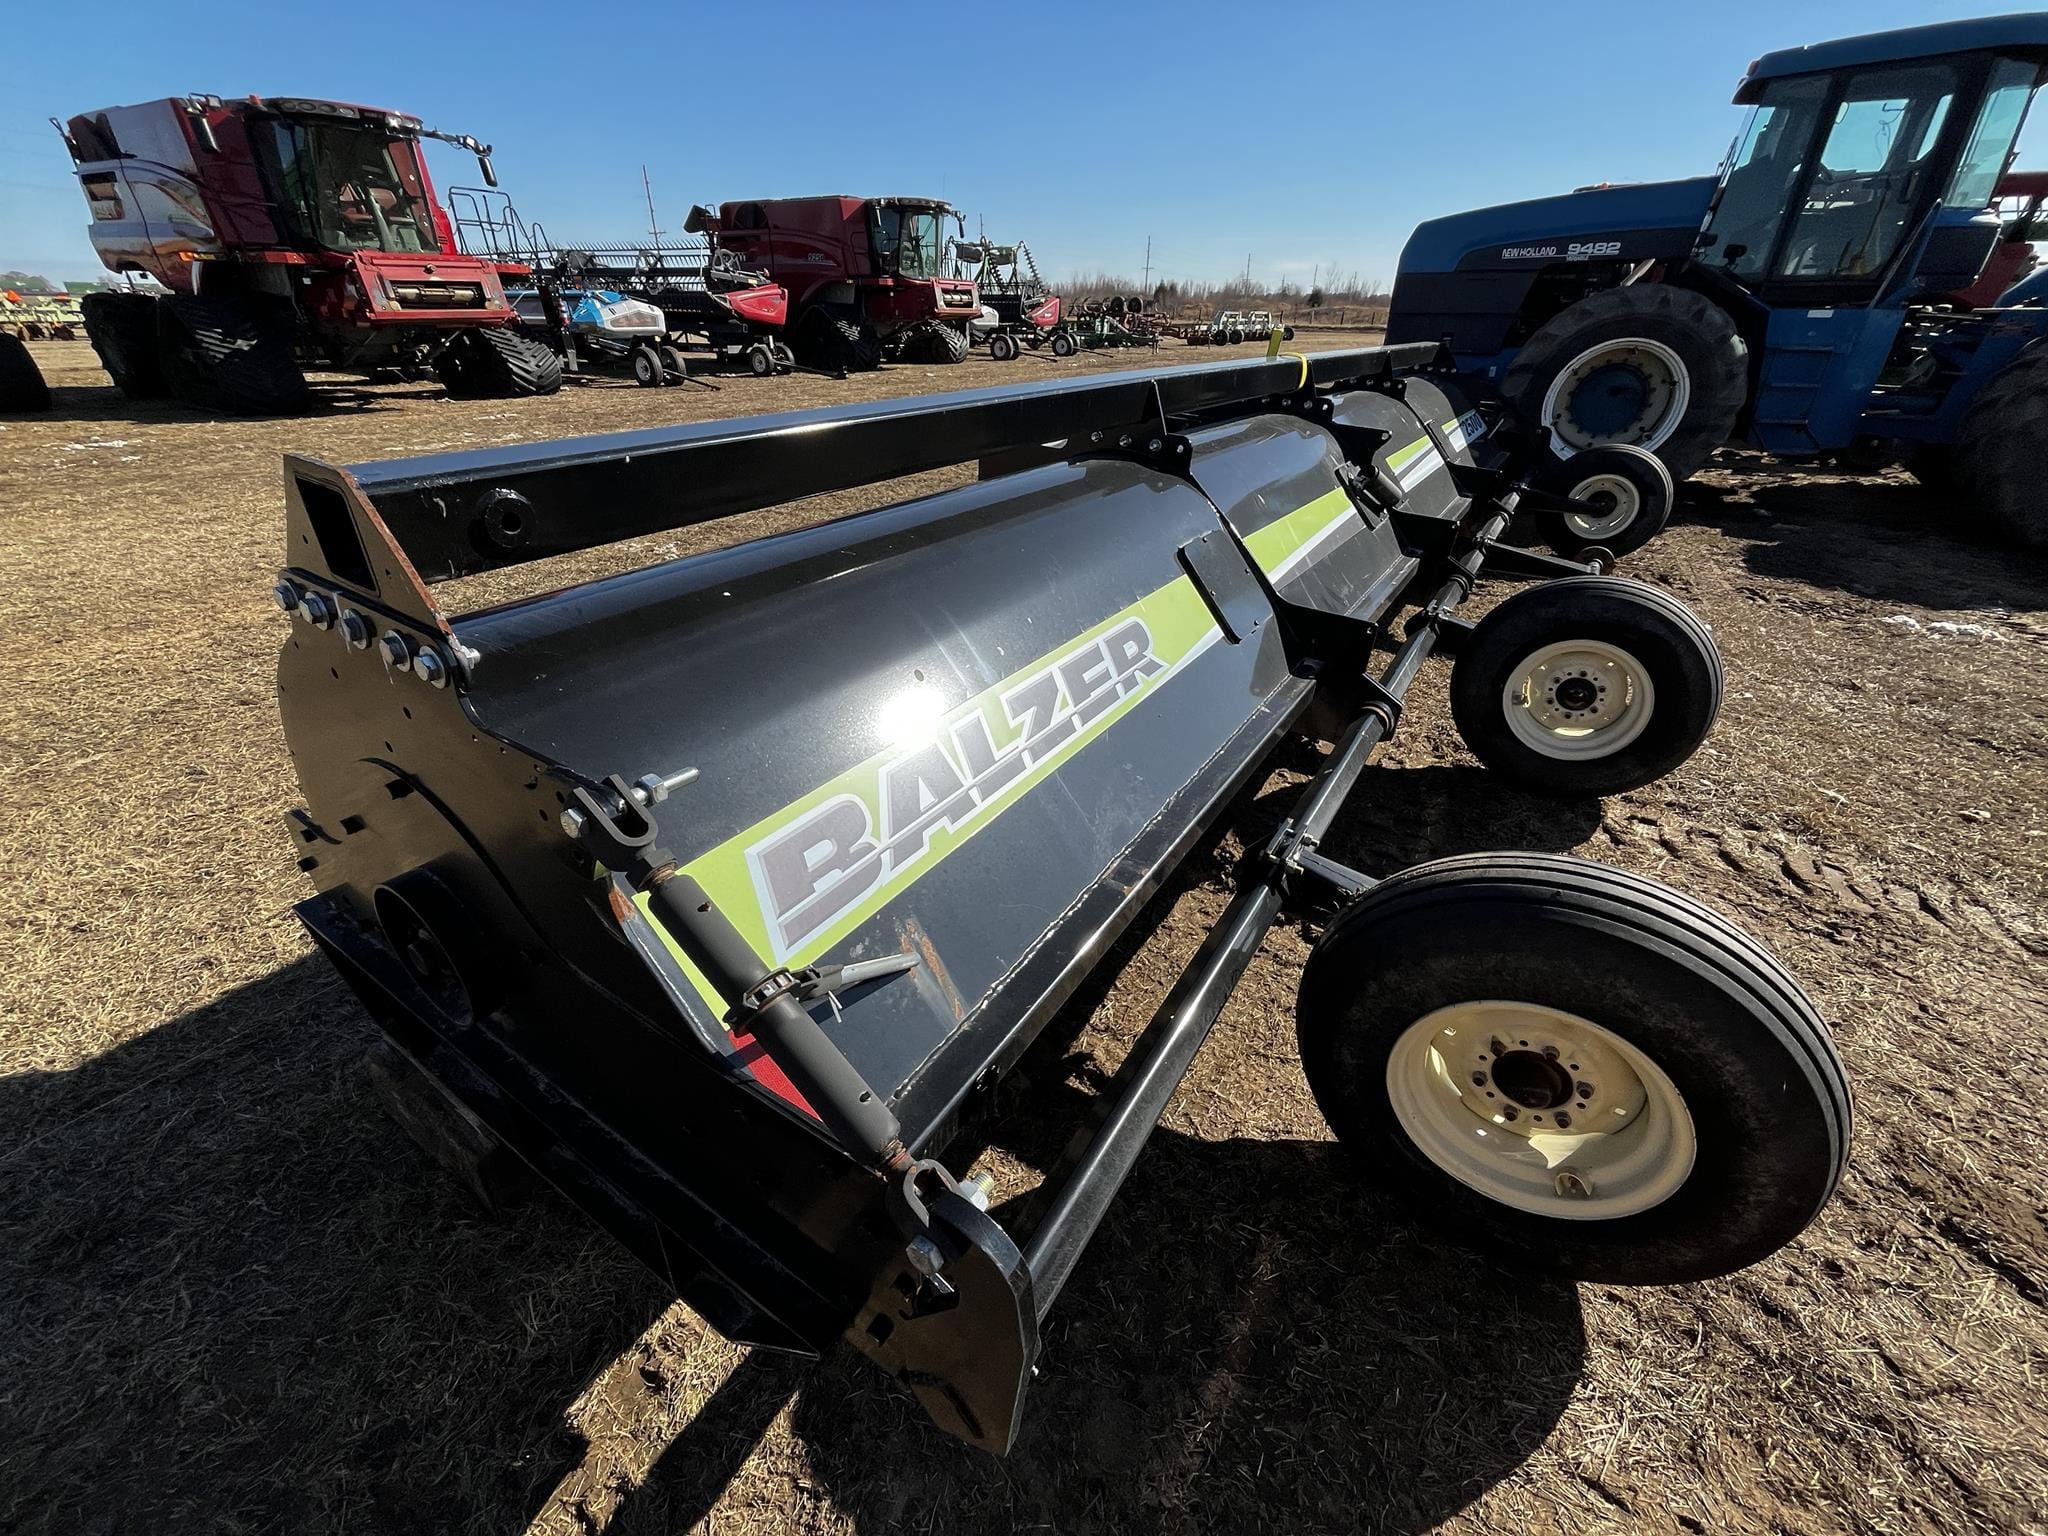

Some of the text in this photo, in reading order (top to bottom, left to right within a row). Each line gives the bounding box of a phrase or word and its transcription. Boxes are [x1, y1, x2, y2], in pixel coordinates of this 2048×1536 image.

[1502, 241, 1621, 257] NEW HOLLAND 9482
[746, 616, 1170, 962] BALZER
